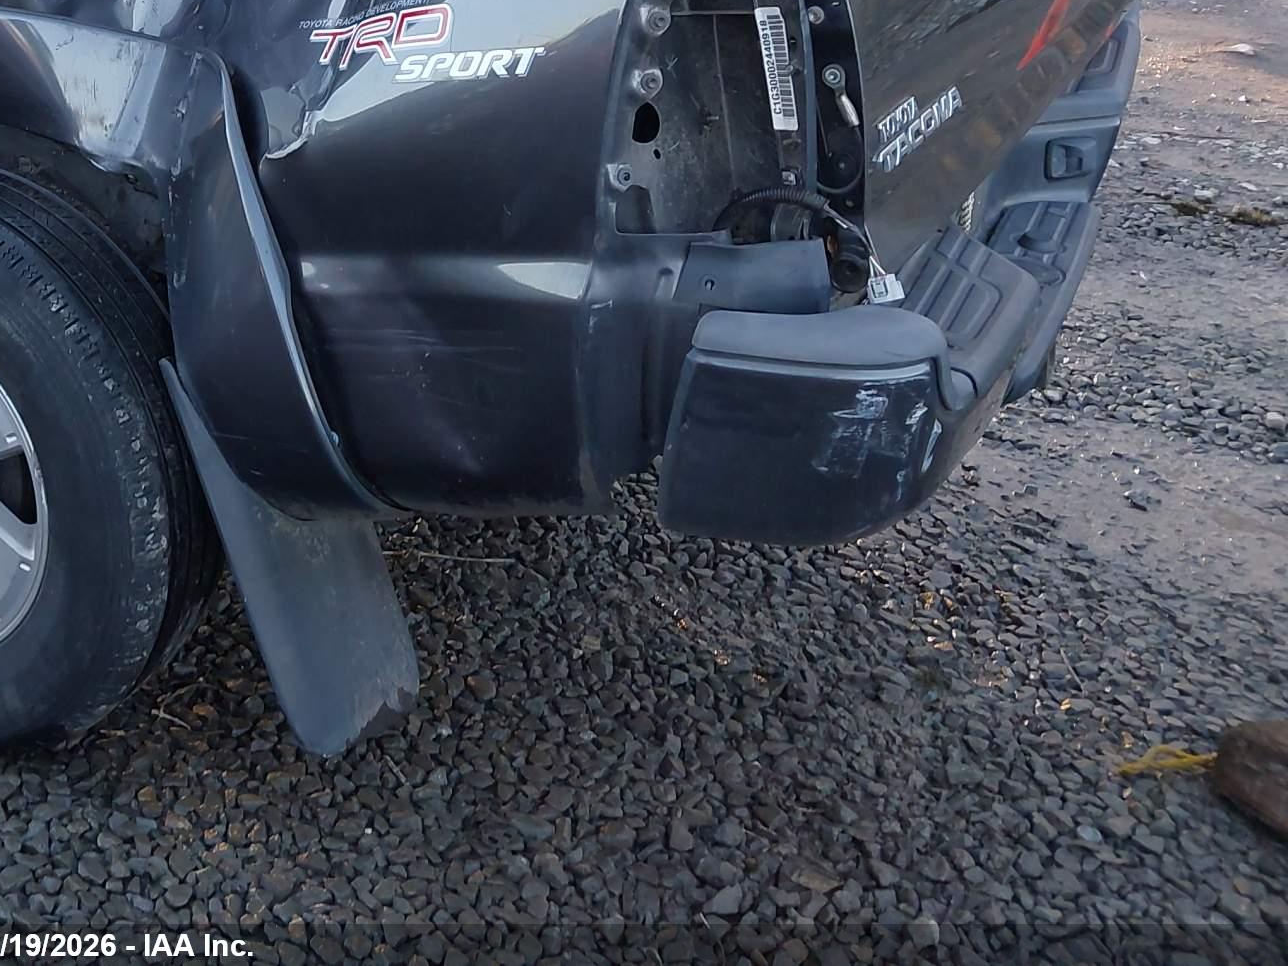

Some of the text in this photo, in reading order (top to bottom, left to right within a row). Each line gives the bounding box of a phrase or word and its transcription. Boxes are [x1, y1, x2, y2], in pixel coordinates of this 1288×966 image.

[299, 17, 333, 29] TOYOTA
[310, 3, 454, 70] TRD
[393, 46, 546, 82] SPORT
[873, 86, 962, 172] TACOMA
